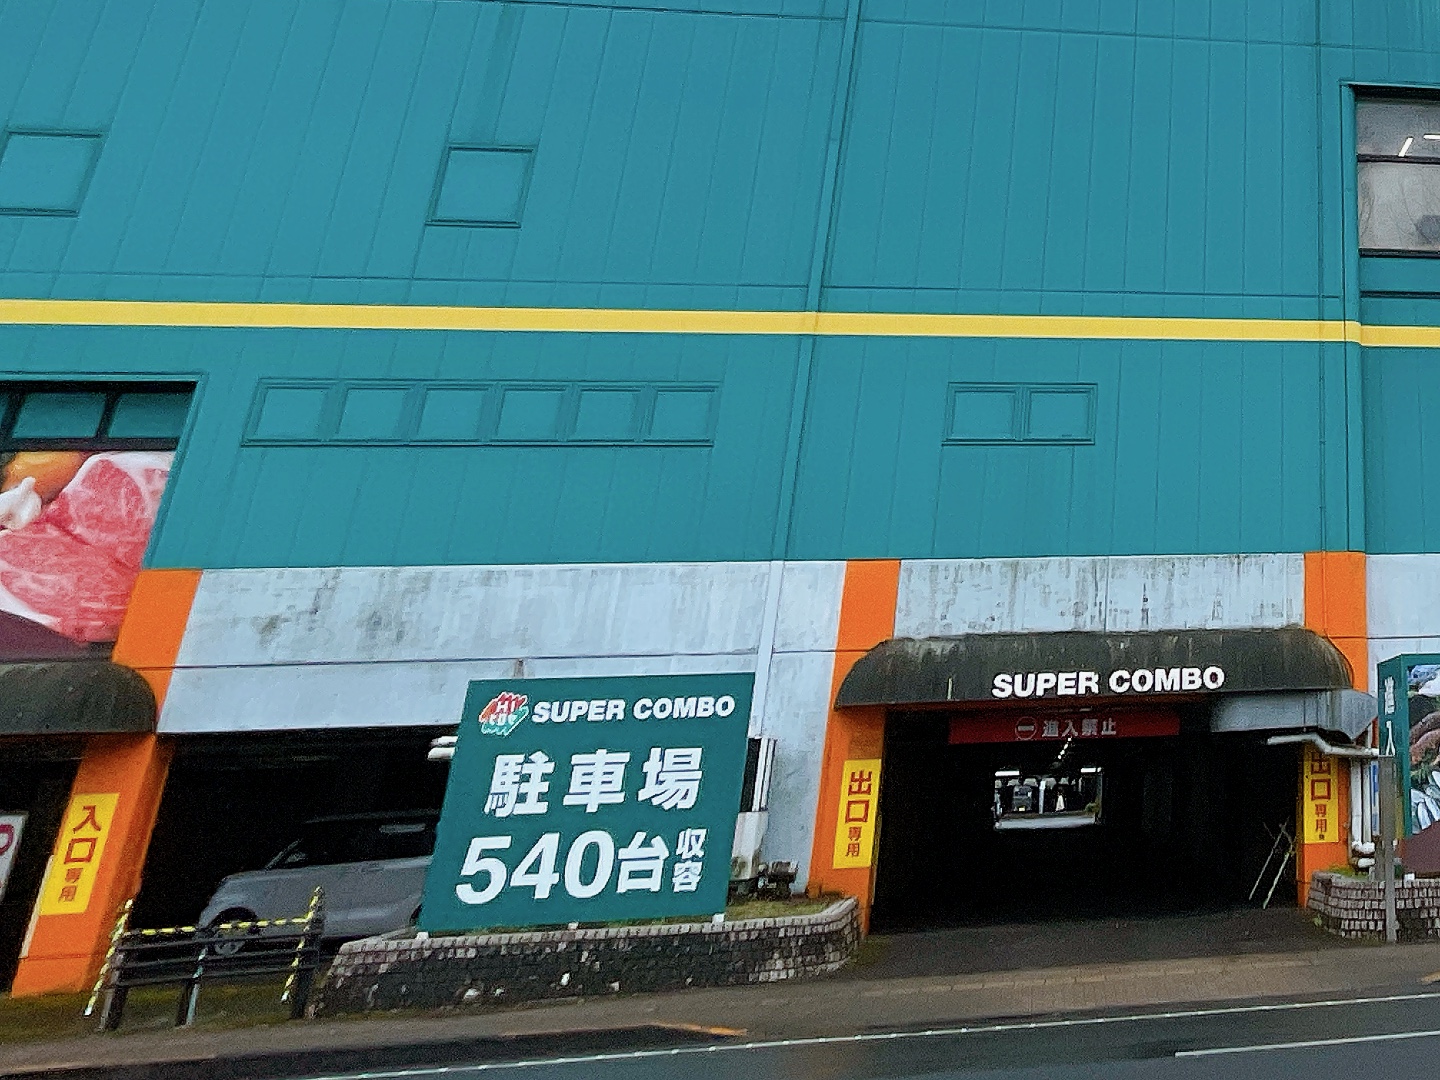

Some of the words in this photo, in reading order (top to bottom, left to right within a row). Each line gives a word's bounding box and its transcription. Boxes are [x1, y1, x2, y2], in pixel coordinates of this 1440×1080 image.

[991, 671, 1100, 699] SUPER
[1108, 666, 1225, 693] COMBO
[531, 698, 626, 723] SUPER
[633, 695, 736, 720] COMBO
[1041, 718, 1117, 738] 進入禁止
[484, 747, 703, 818] 駐車場
